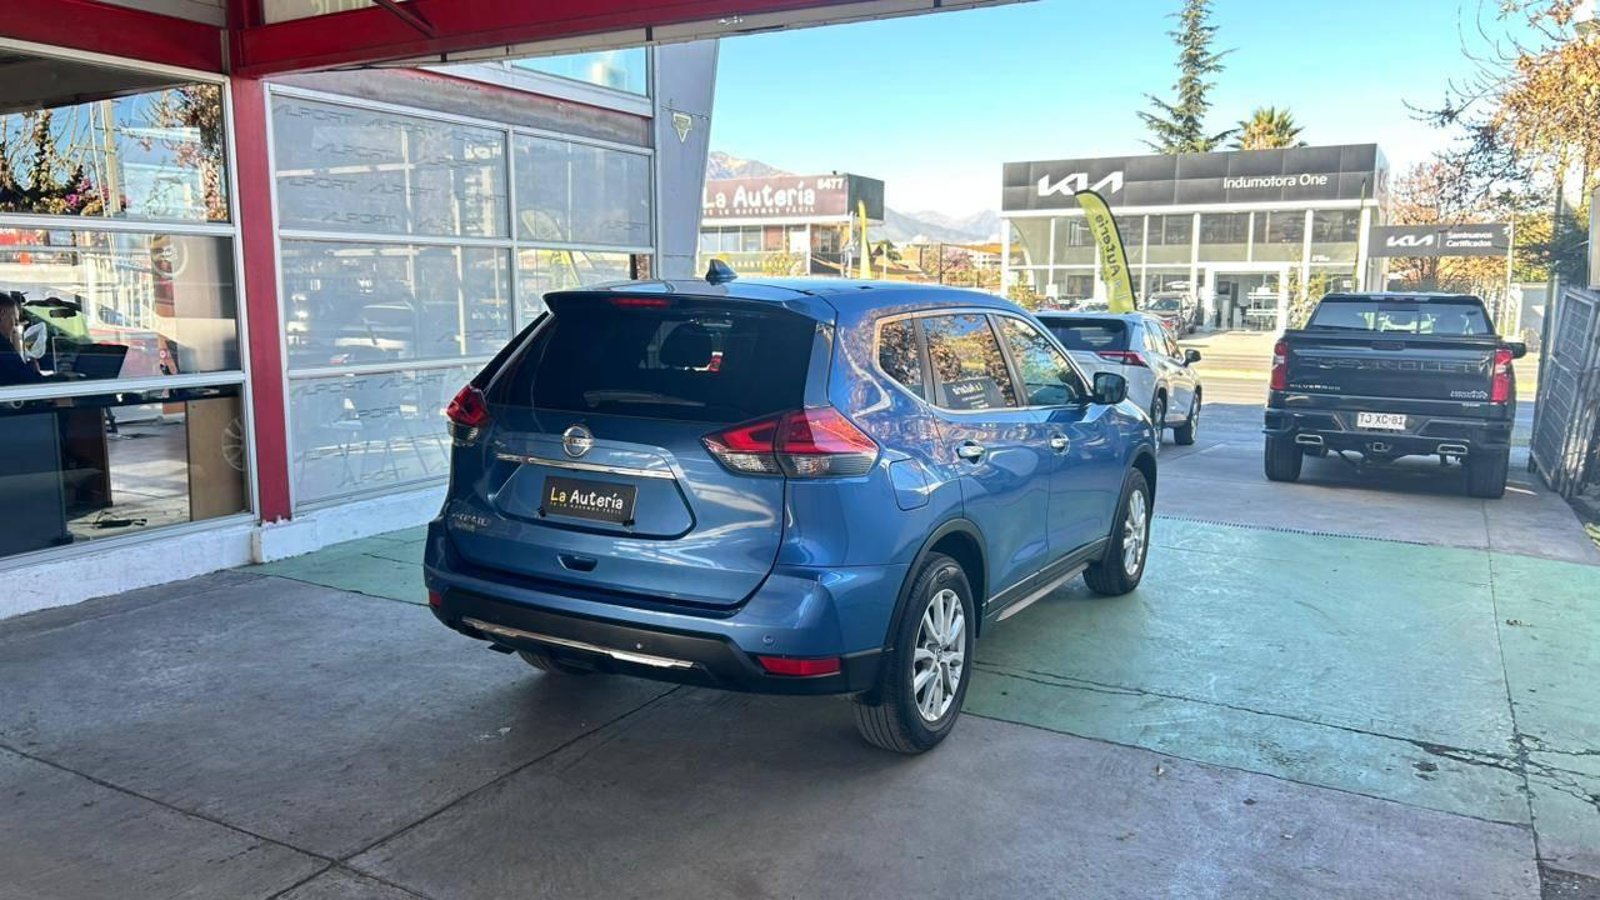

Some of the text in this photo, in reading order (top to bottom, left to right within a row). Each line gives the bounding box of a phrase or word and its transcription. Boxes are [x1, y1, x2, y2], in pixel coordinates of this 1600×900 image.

[1038, 171, 1123, 196] KIA
[1223, 173, 1328, 189] Indumotora One
[702, 181, 816, 208] La Autería
[1386, 234, 1434, 247] KIA
[550, 486, 624, 510] La Autería
